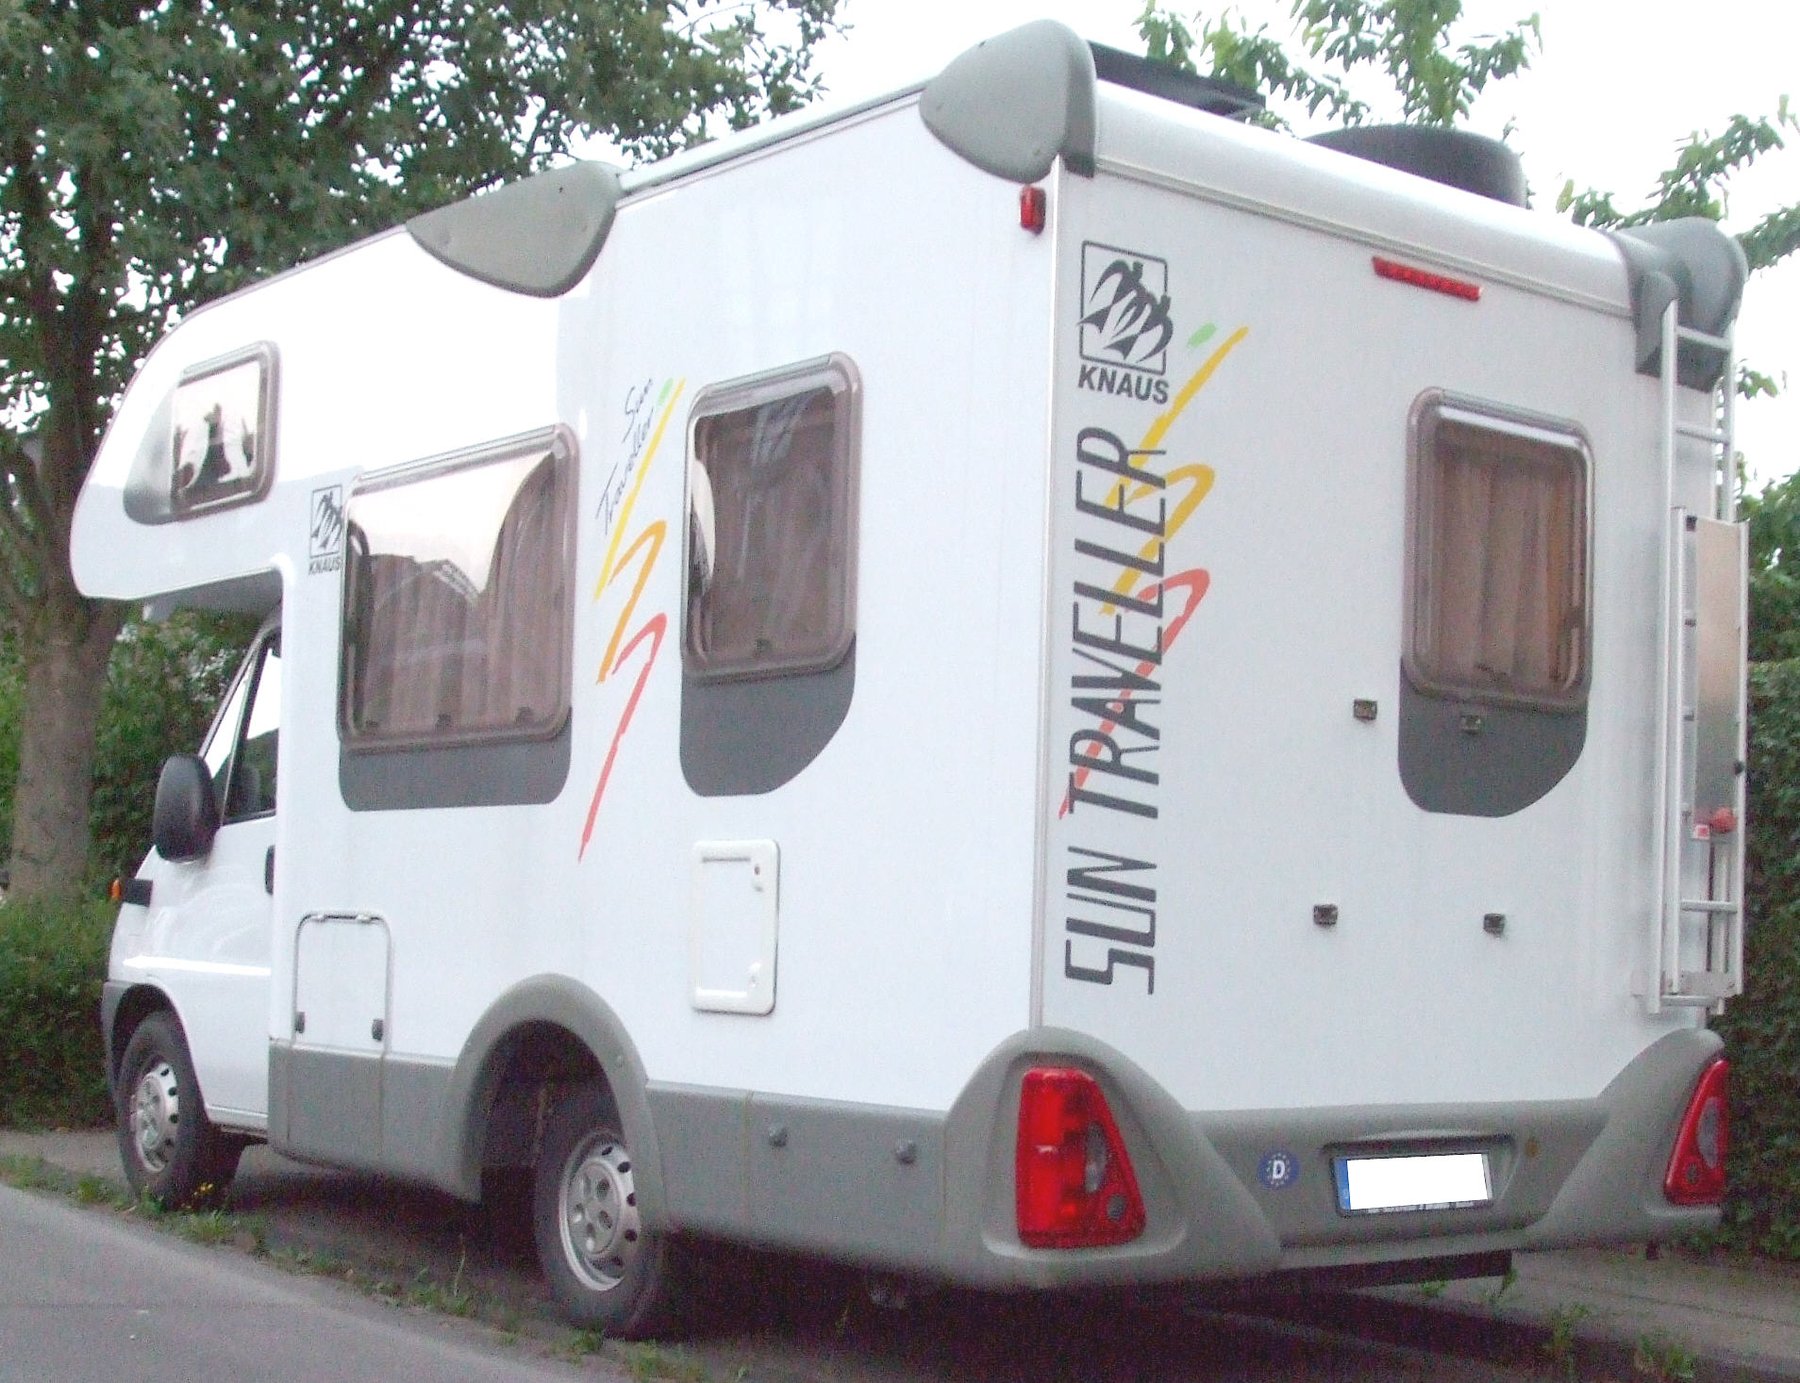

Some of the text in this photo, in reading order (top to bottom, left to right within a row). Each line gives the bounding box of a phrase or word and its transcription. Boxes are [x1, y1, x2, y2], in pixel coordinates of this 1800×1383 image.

[1077, 364, 1169, 405] KNAUS
[308, 557, 341, 574] KNAUS
[1065, 427, 1167, 995] SUN TRAVELLER
[1272, 1160, 1286, 1180] D
